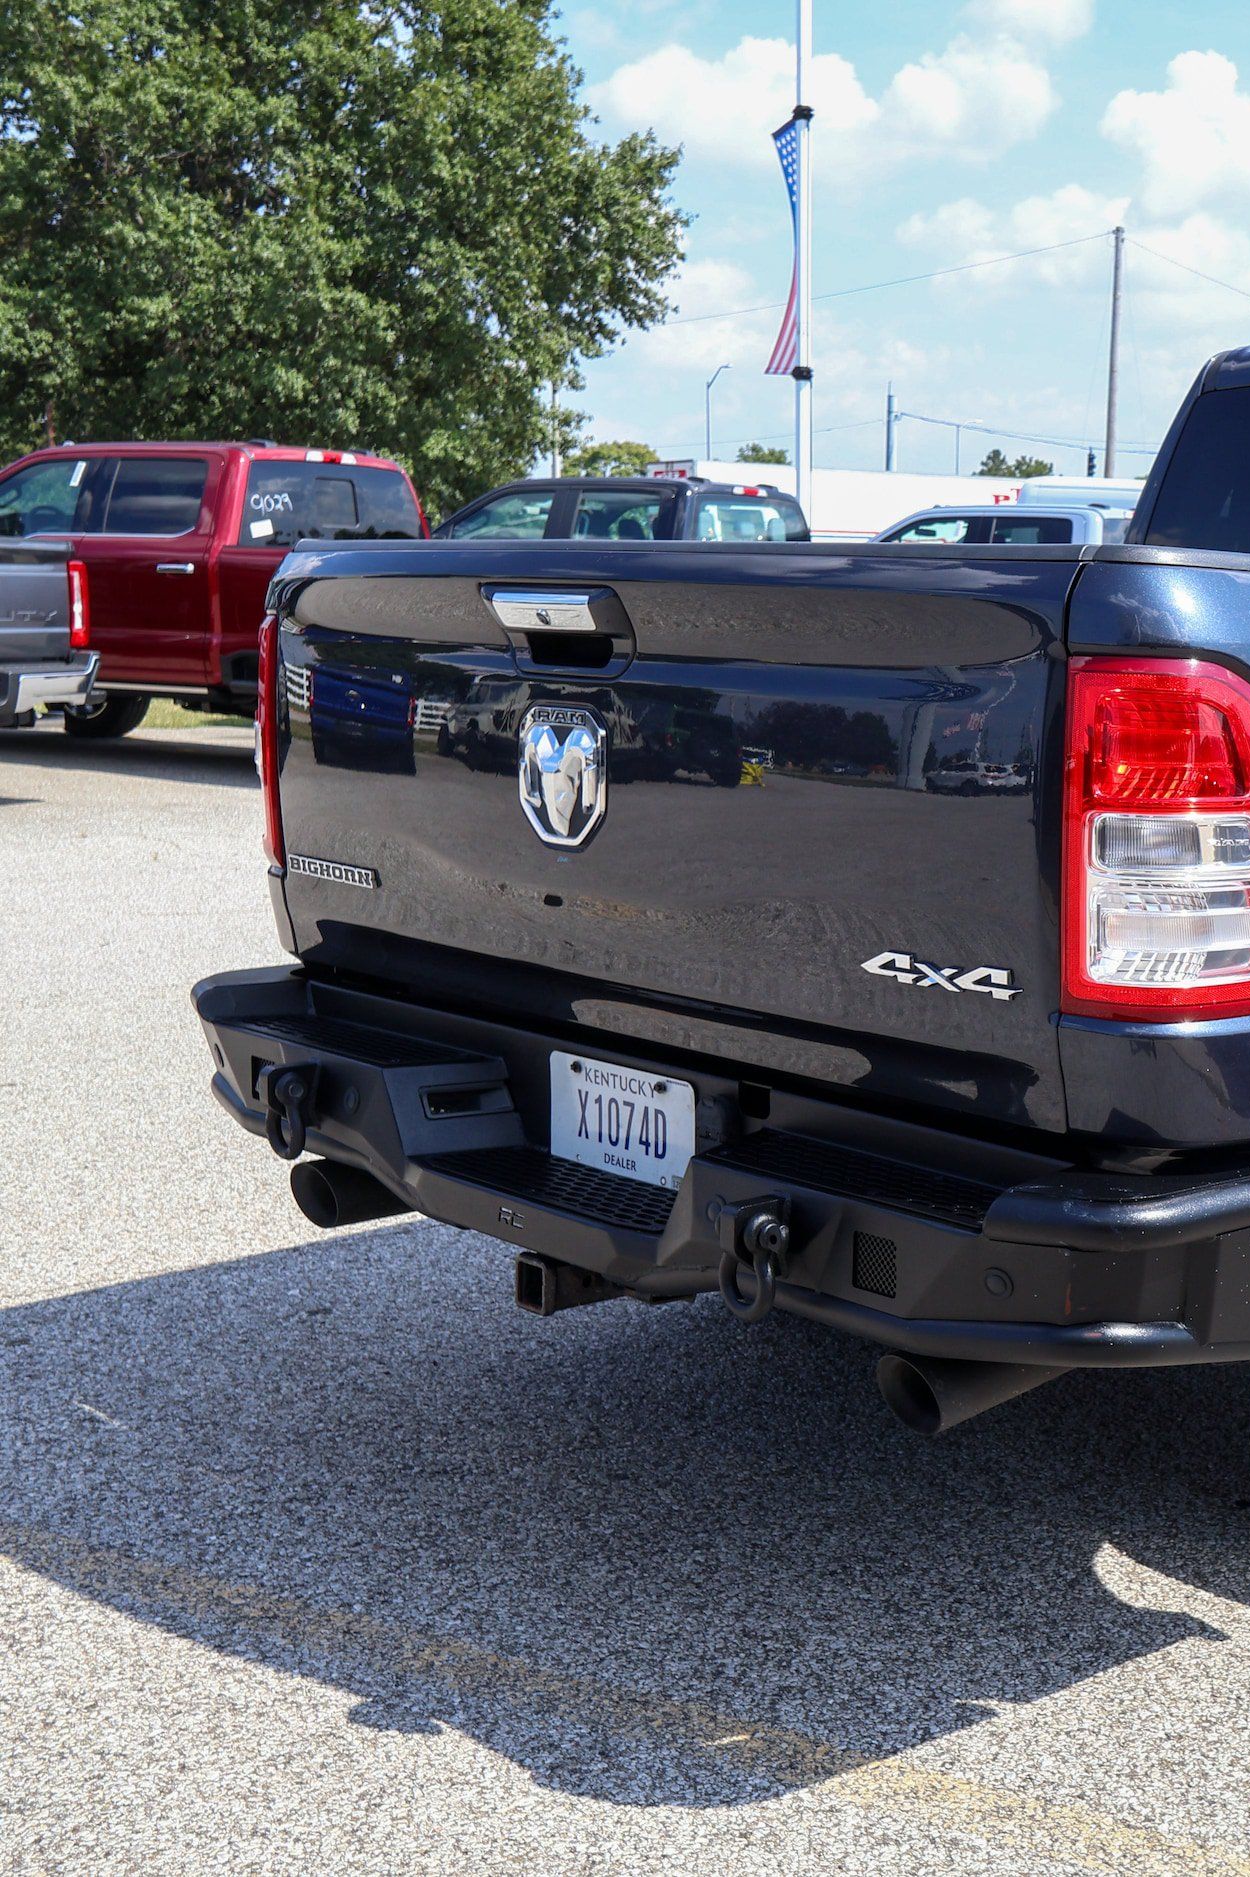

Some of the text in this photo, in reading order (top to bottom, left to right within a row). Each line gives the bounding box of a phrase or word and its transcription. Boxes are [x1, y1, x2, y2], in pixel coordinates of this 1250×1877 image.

[538, 709, 586, 726] RAM
[289, 854, 373, 889] BIGHORN
[584, 1066, 656, 1098] KENTUCKY
[577, 1088, 667, 1160] X1074D
[604, 1152, 637, 1172] DEALER
